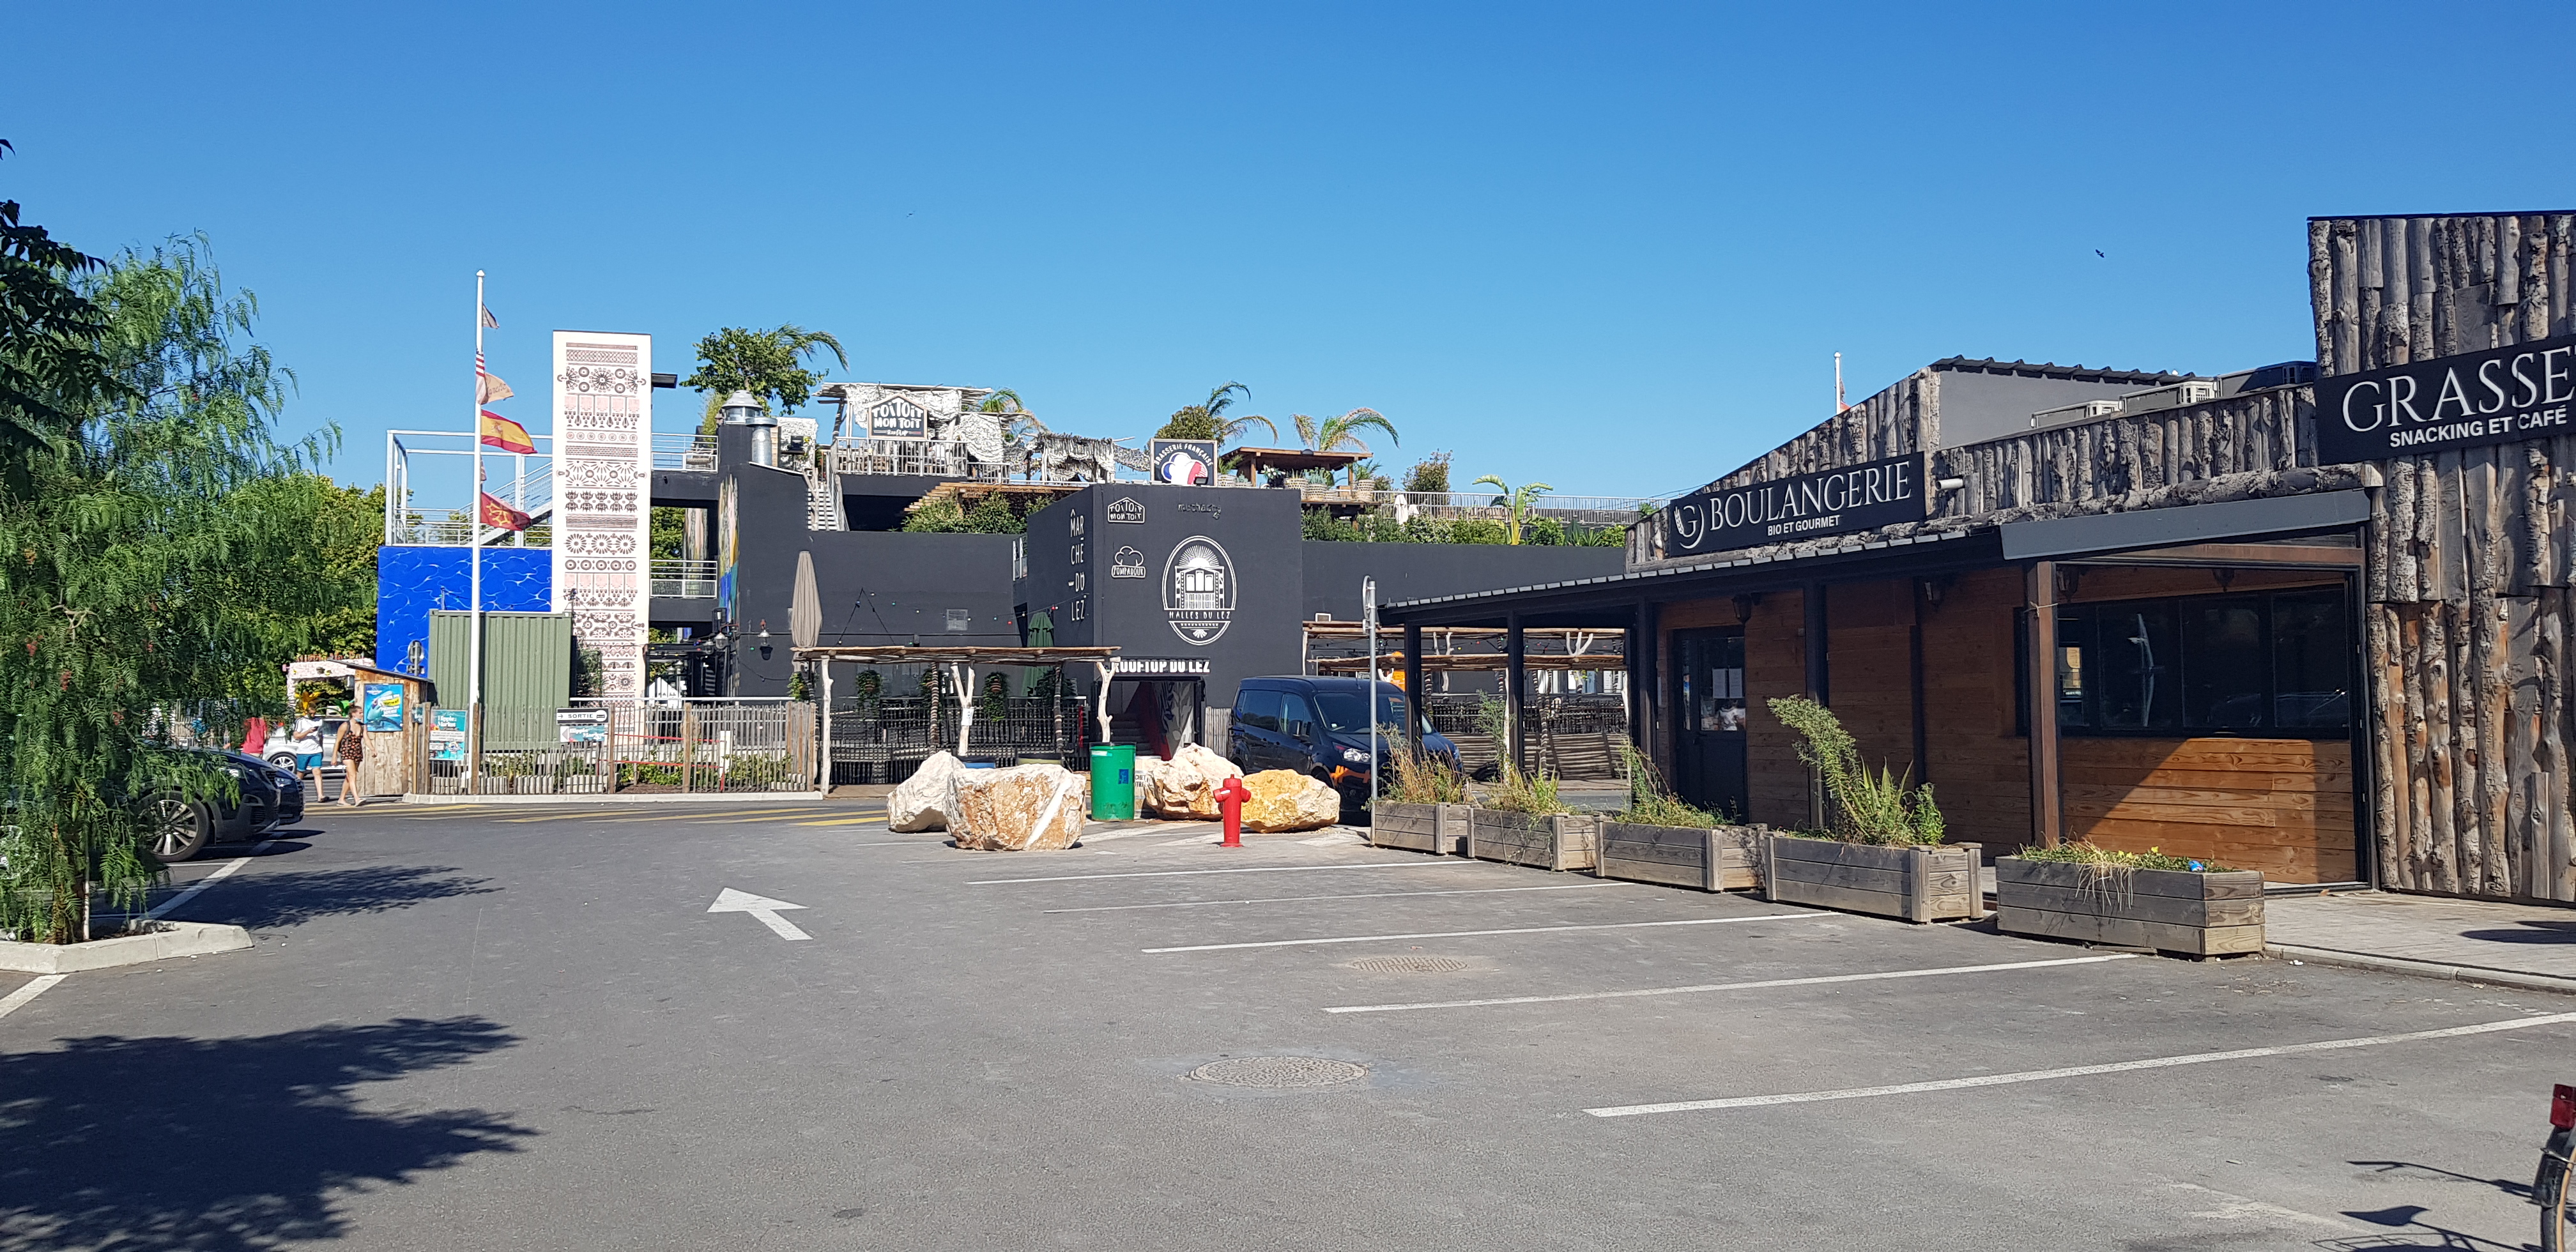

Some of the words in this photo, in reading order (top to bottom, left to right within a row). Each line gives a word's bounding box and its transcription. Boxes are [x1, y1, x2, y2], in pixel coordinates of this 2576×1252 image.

[2342, 344, 2576, 432] GRASSE
[874, 417, 897, 429] MON
[2389, 420, 2484, 448] SNACKING
[2488, 416, 2513, 435] ET
[2517, 404, 2568, 431] CAFÉ
[1154, 443, 1183, 466] BRASSERIE
[1184, 443, 1214, 467] FRANÇAISE
[1710, 461, 1912, 531] BOULANGERIE
[1767, 524, 1781, 537] BIO
[1783, 522, 1793, 535] ET
[1795, 514, 1840, 533] GOURMET
[1113, 566, 1144, 576] POMPADOUR
[1071, 600, 1085, 622] LEZ
[1169, 611, 1199, 620] HALLES
[1169, 659, 1185, 673] DU
[1188, 659, 1210, 673] LEZ
